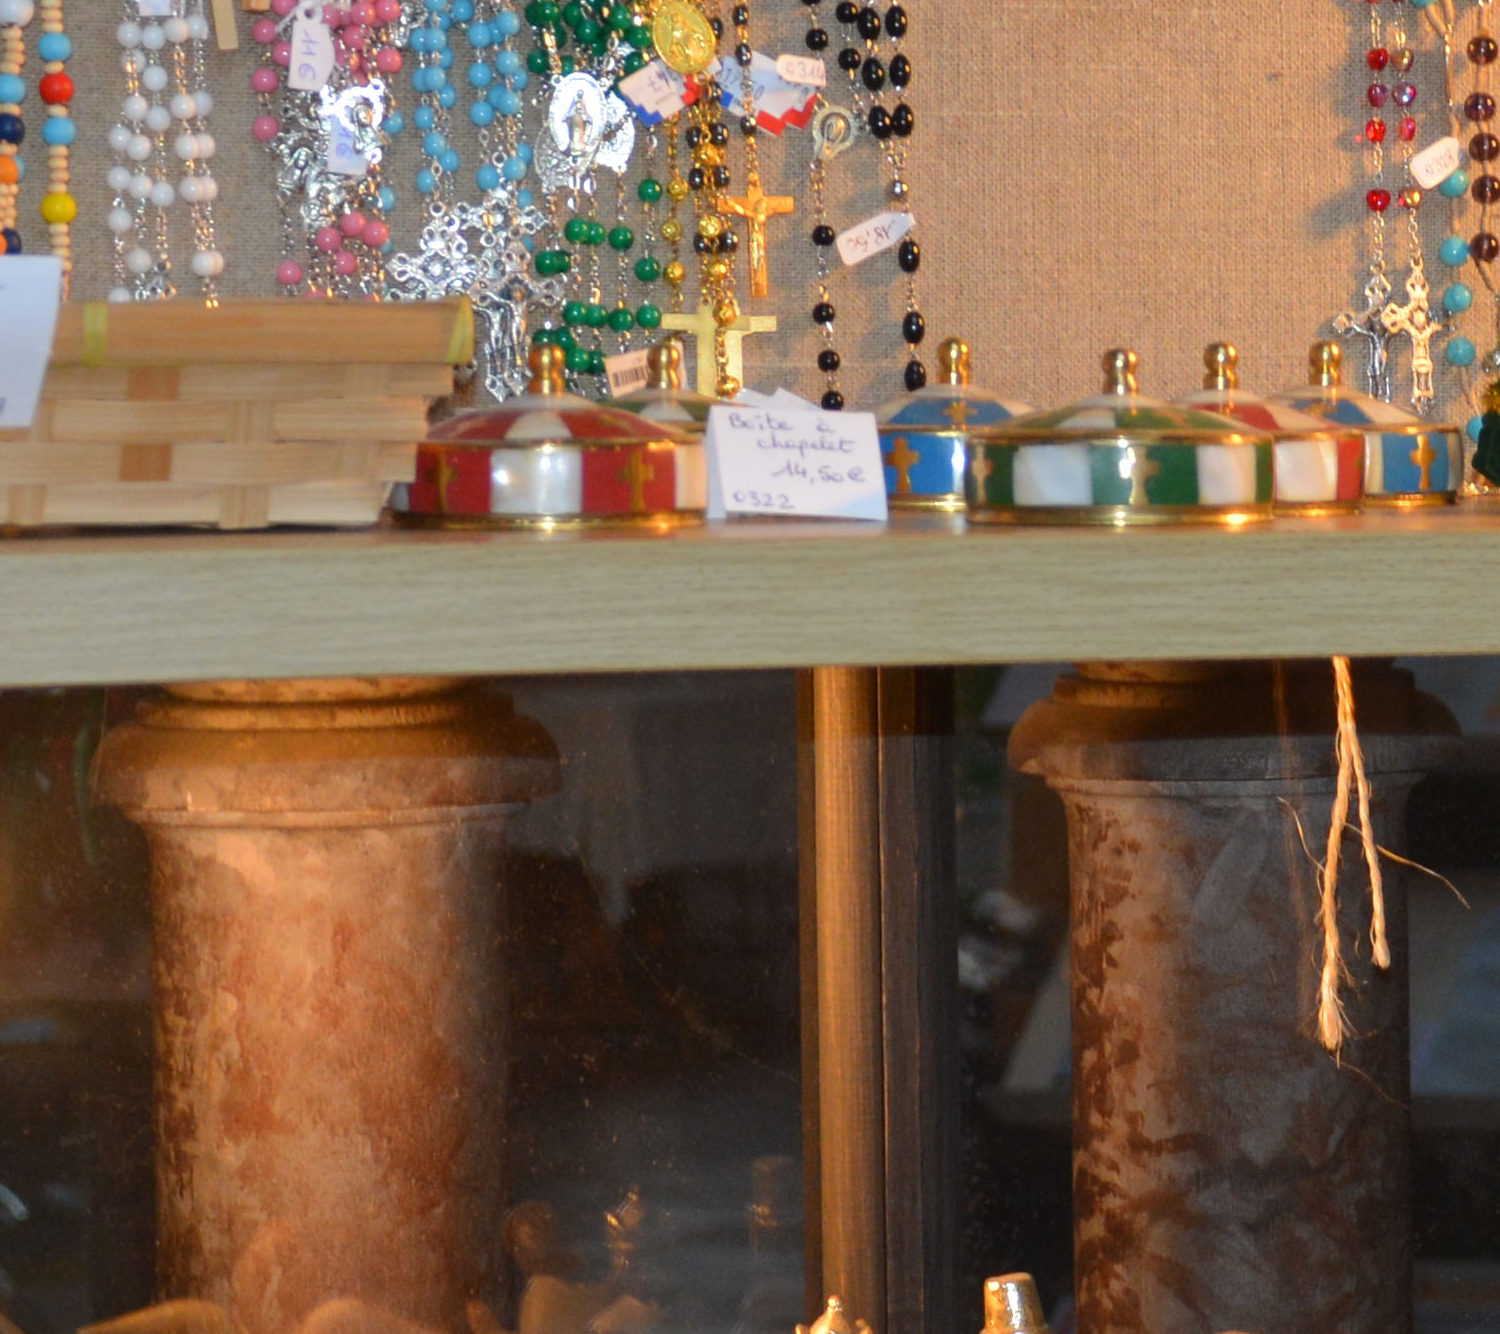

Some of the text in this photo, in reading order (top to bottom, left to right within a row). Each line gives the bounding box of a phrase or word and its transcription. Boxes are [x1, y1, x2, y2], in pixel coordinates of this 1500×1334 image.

[816, 418, 834, 433] à
[757, 432, 856, 458] chapelet
[733, 489, 796, 510] 0322
